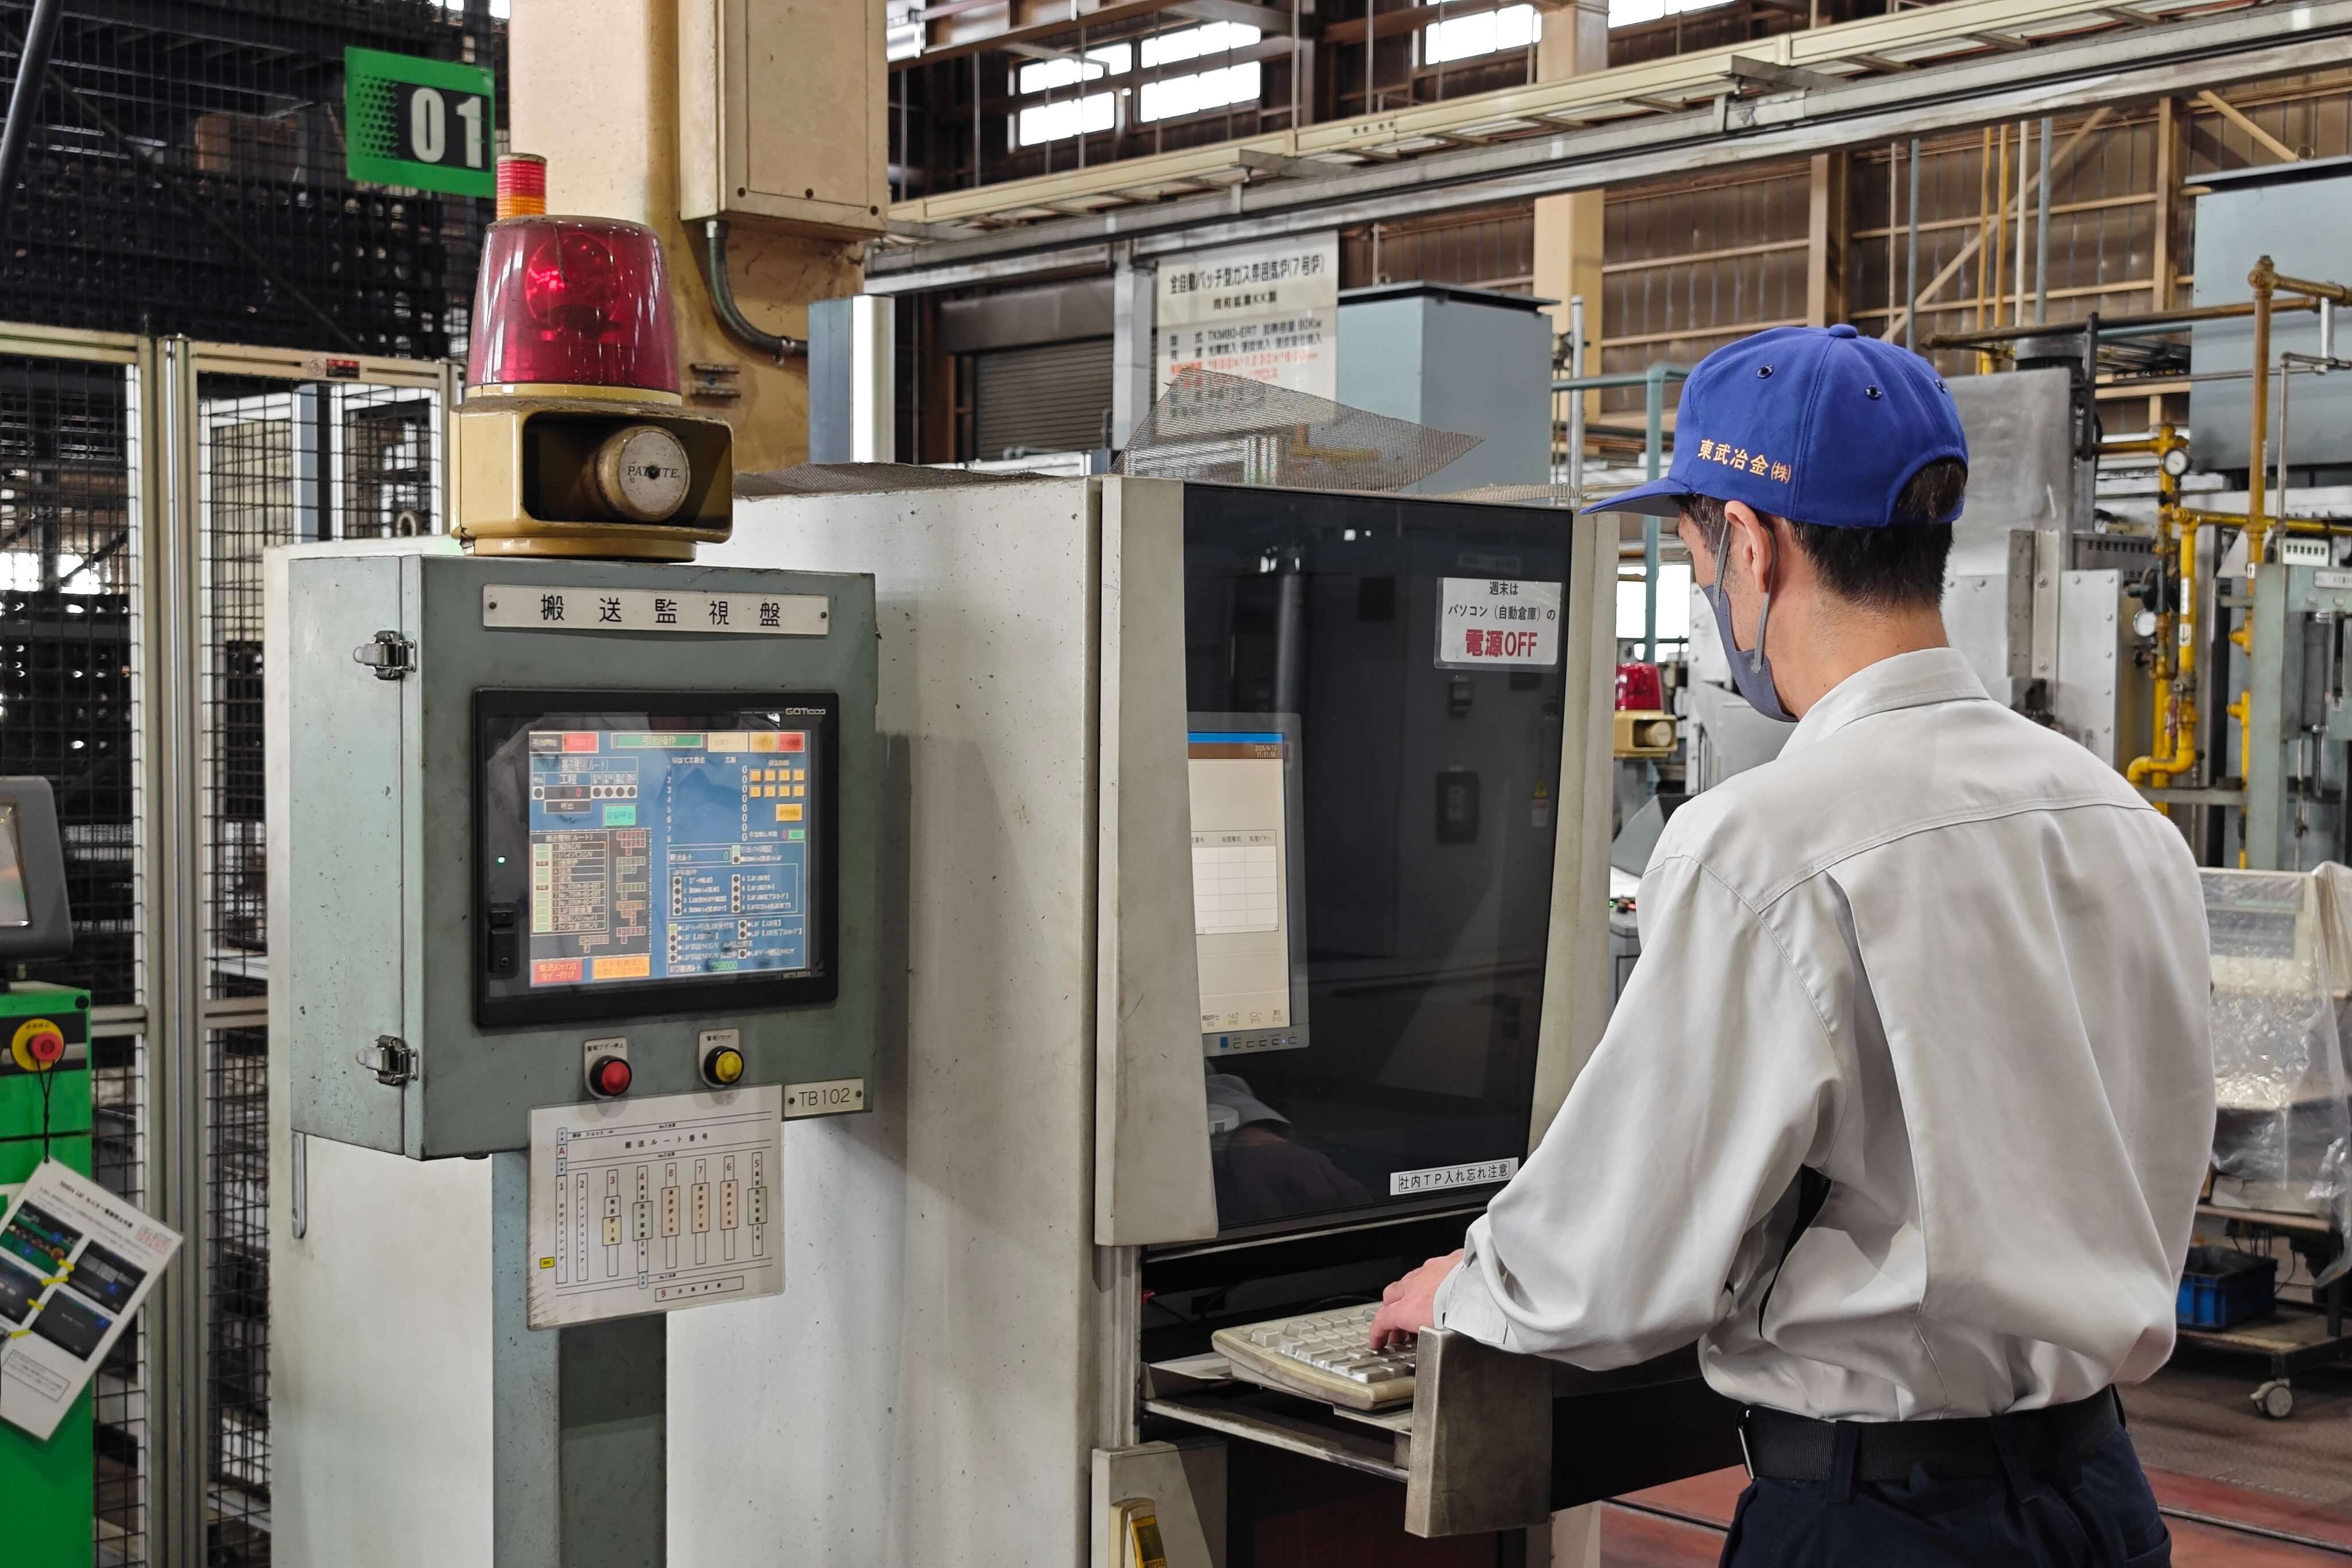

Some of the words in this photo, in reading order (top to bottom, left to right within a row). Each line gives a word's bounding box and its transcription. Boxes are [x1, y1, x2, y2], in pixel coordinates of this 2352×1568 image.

[411, 87, 482, 168] 01
[1489, 581, 1518, 596] 週末は
[541, 594, 781, 628] 搬送監視盤
[1466, 629, 1538, 657] 電源OFF
[799, 1087, 850, 1107] TB102
[559, 1147, 566, 1156] A
[726, 1163, 732, 1171] 6
[755, 1159, 760, 1167] 5
[669, 1169, 674, 1177] 8
[698, 1166, 703, 1174] 7
[610, 1176, 615, 1184] 3
[1400, 1163, 1508, 1190] 社内TP入れ忘れ注意
[559, 1182, 564, 1191] 1
[579, 1180, 585, 1188] 2
[661, 1290, 666, 1298] 9
